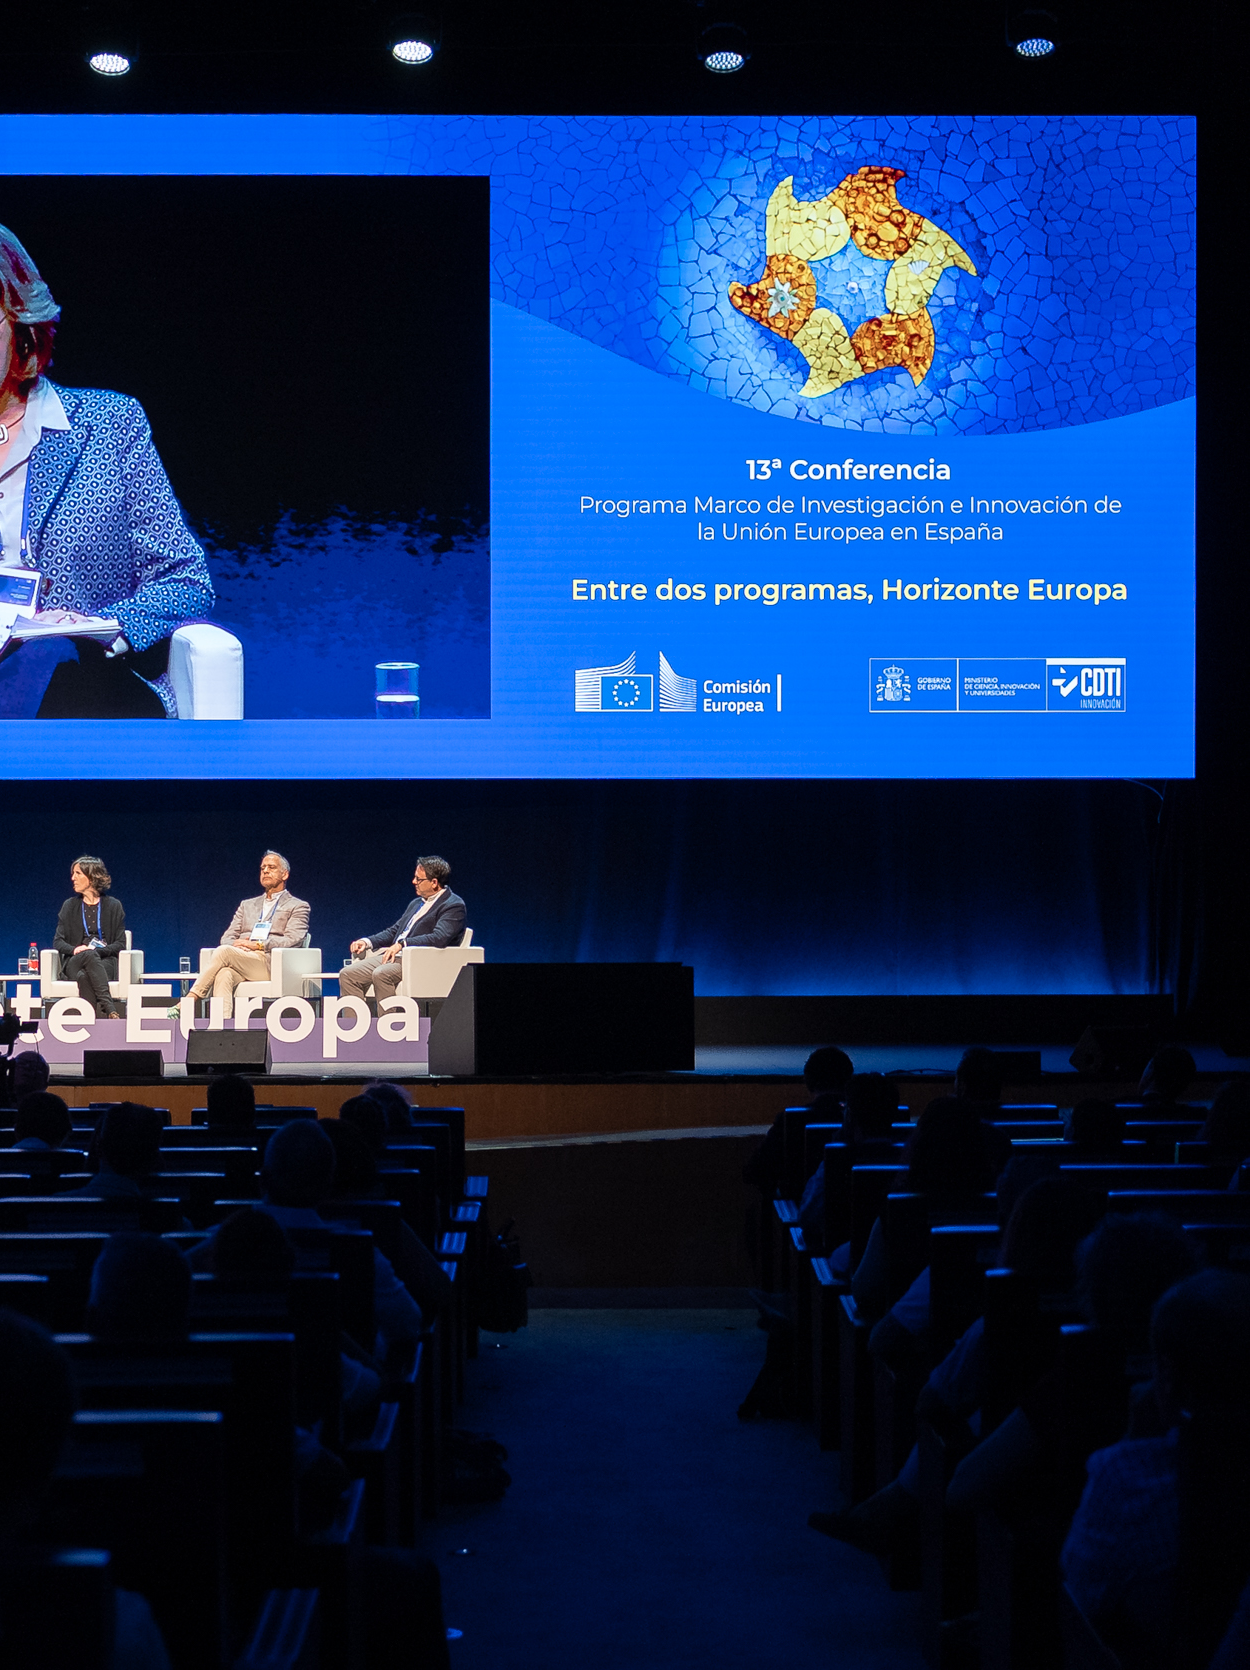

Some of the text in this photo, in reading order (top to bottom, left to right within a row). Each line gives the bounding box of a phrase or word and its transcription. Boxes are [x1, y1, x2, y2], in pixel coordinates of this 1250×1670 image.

[746, 458, 950, 480] 13ª Conferencia
[581, 496, 1121, 518] Programa Marco de Investigación e Innovación de
[699, 523, 1002, 544] la Unión Europea en España
[573, 578, 1127, 605] Entre dos programas, Horizonte Europa
[704, 679, 770, 693] Comisión
[917, 677, 952, 685] GOBIERNO
[917, 682, 952, 691] DE ESPAÑA
[1000, 682, 1041, 690] INNOVACIÓN
[1081, 668, 1121, 696] CDTI
[704, 699, 764, 715] Europea
[1080, 698, 1121, 710] INNOVACIÓN
[126, 983, 420, 1058] Europa
